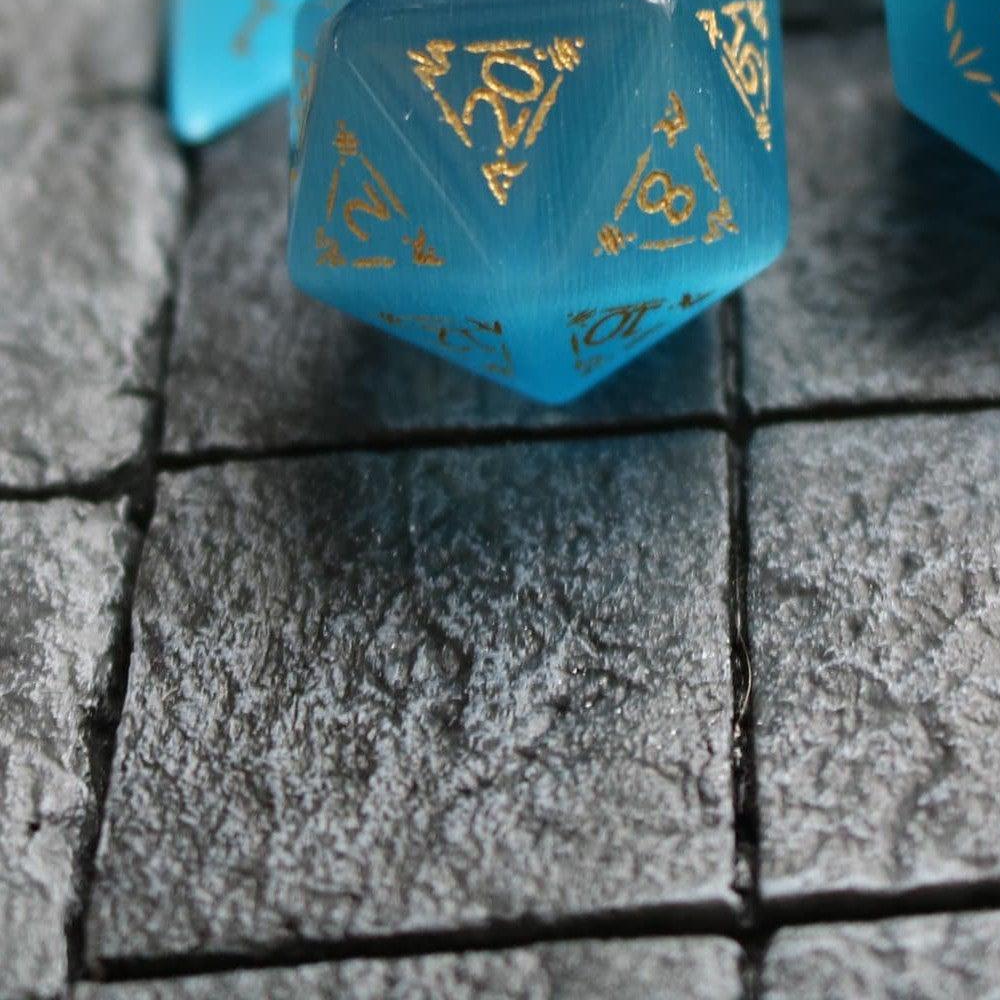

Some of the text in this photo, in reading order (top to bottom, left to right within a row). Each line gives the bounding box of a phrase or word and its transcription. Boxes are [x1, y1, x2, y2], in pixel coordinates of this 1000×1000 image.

[463, 50, 544, 148] 20
[343, 181, 392, 240] 2
[636, 170, 696, 227] 8
